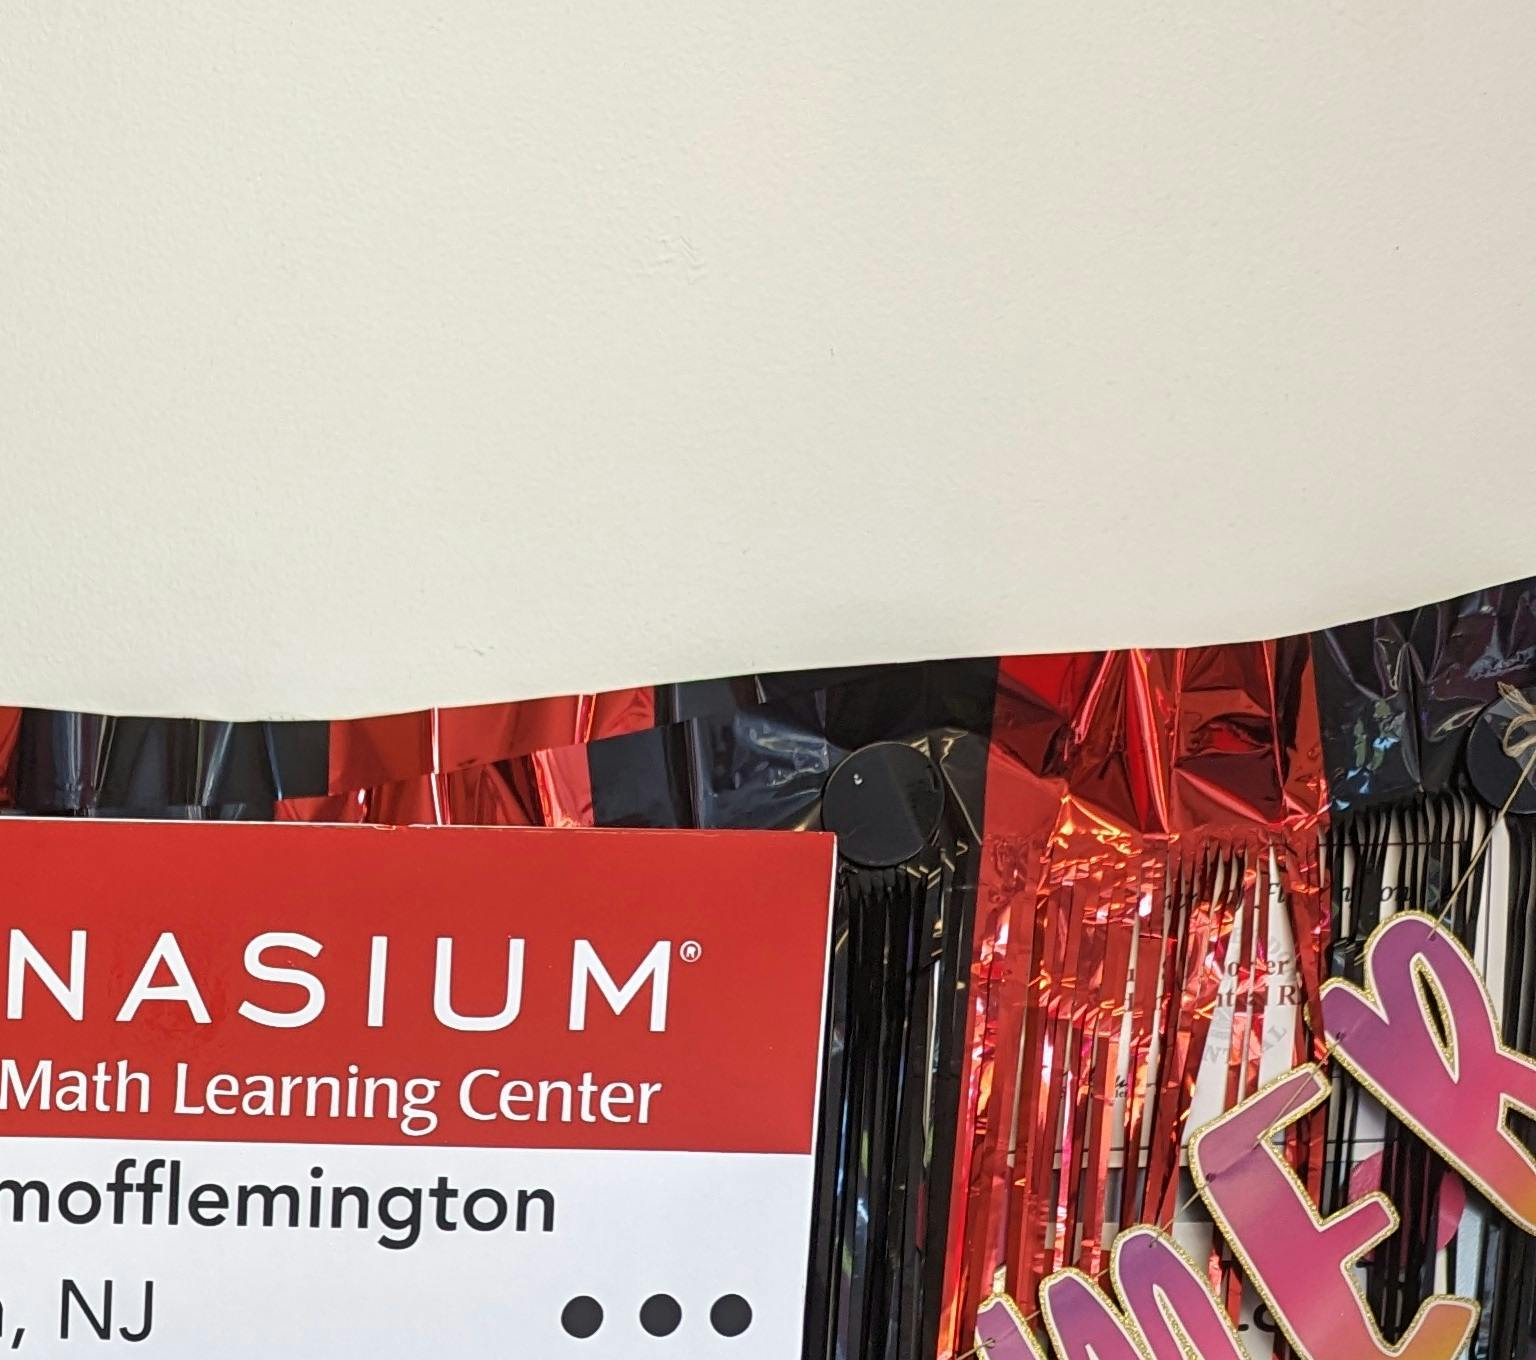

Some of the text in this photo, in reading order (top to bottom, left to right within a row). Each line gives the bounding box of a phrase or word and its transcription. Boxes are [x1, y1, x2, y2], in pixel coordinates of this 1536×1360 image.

[173, 1062, 440, 1136] Learning
[459, 1068, 662, 1124] Center
[60, 1279, 155, 1342] NJ
